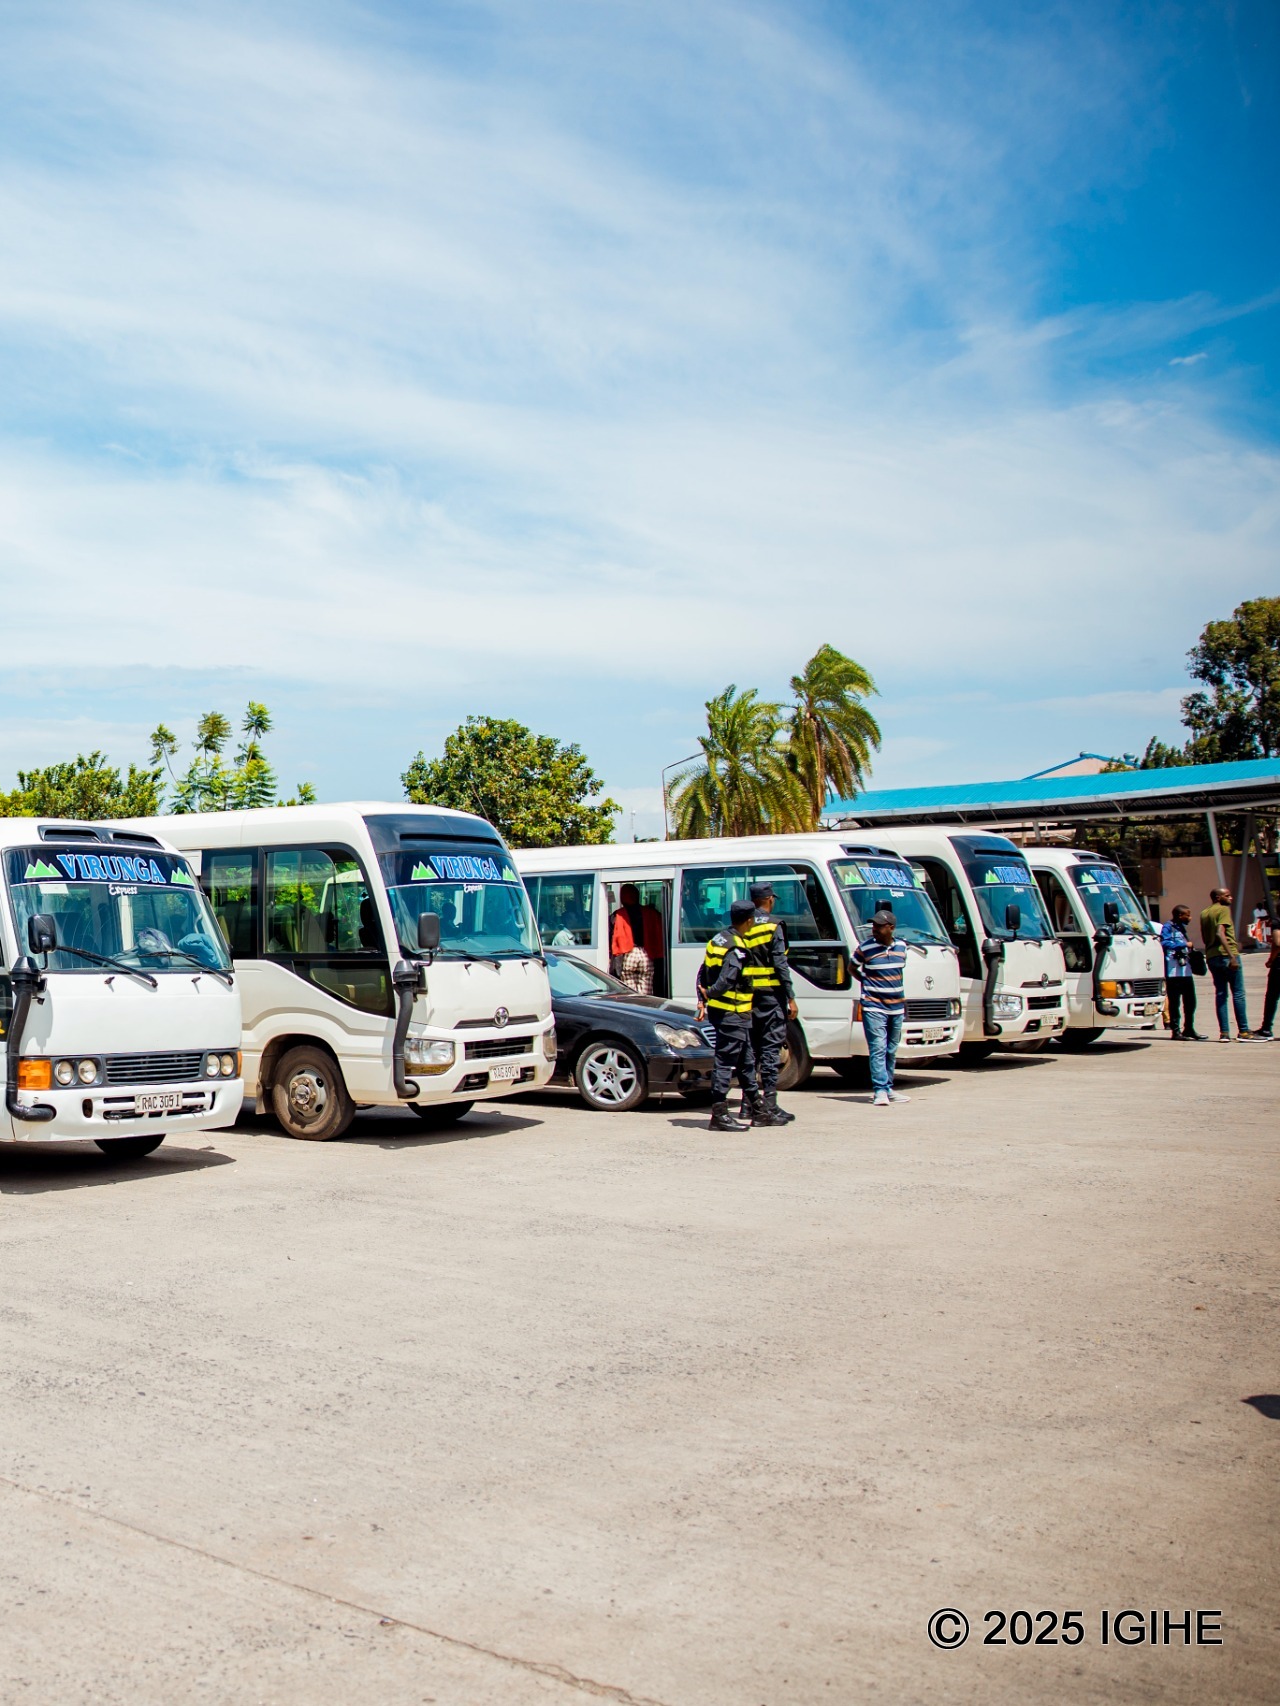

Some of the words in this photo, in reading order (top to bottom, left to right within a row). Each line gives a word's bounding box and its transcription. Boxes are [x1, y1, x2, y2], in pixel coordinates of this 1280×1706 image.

[57, 854, 166, 883] VIRUNGA
[429, 856, 502, 880] VIRUNGA
[109, 884, 138, 896] Express
[142, 1096, 158, 1110] RAC
